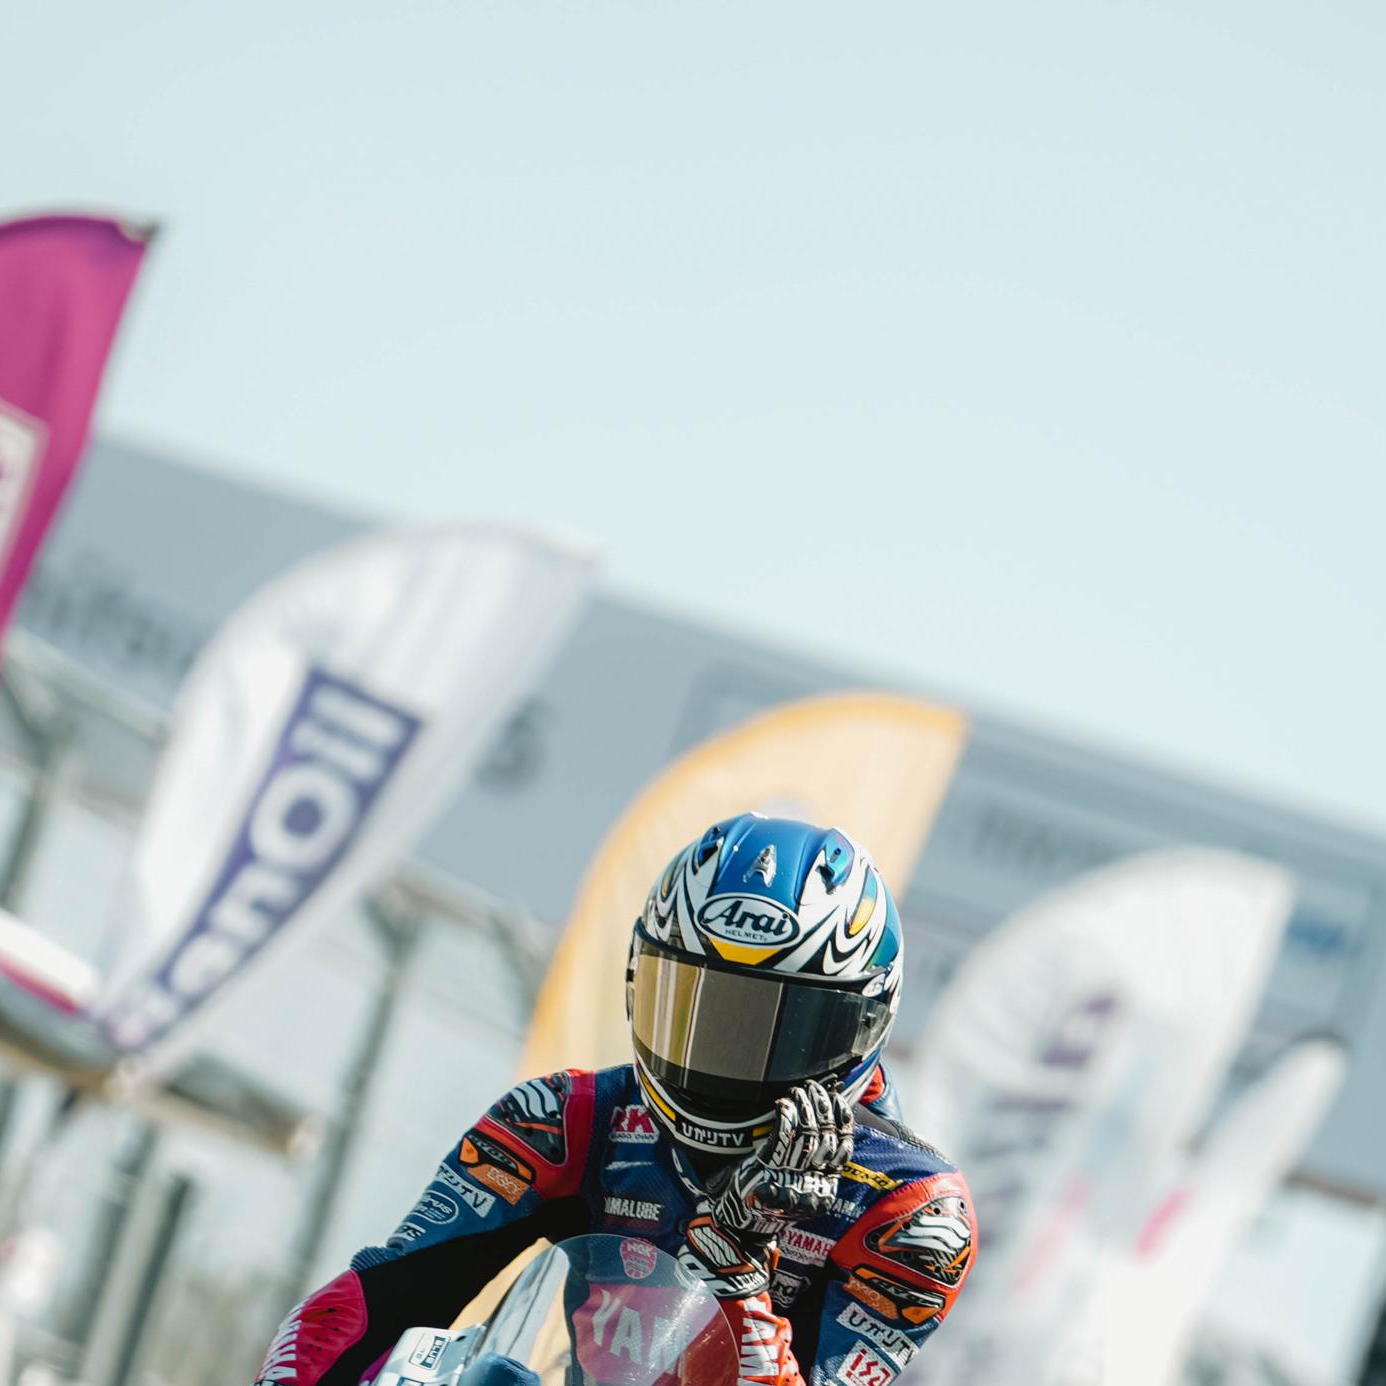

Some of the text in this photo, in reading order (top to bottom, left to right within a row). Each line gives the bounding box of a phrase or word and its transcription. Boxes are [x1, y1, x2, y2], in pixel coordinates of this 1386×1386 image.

[701, 900, 790, 936] Arai
[725, 928, 767, 941] HELMET
[626, 1242, 654, 1258] NGK
[788, 1230, 835, 1256] YAMAH
